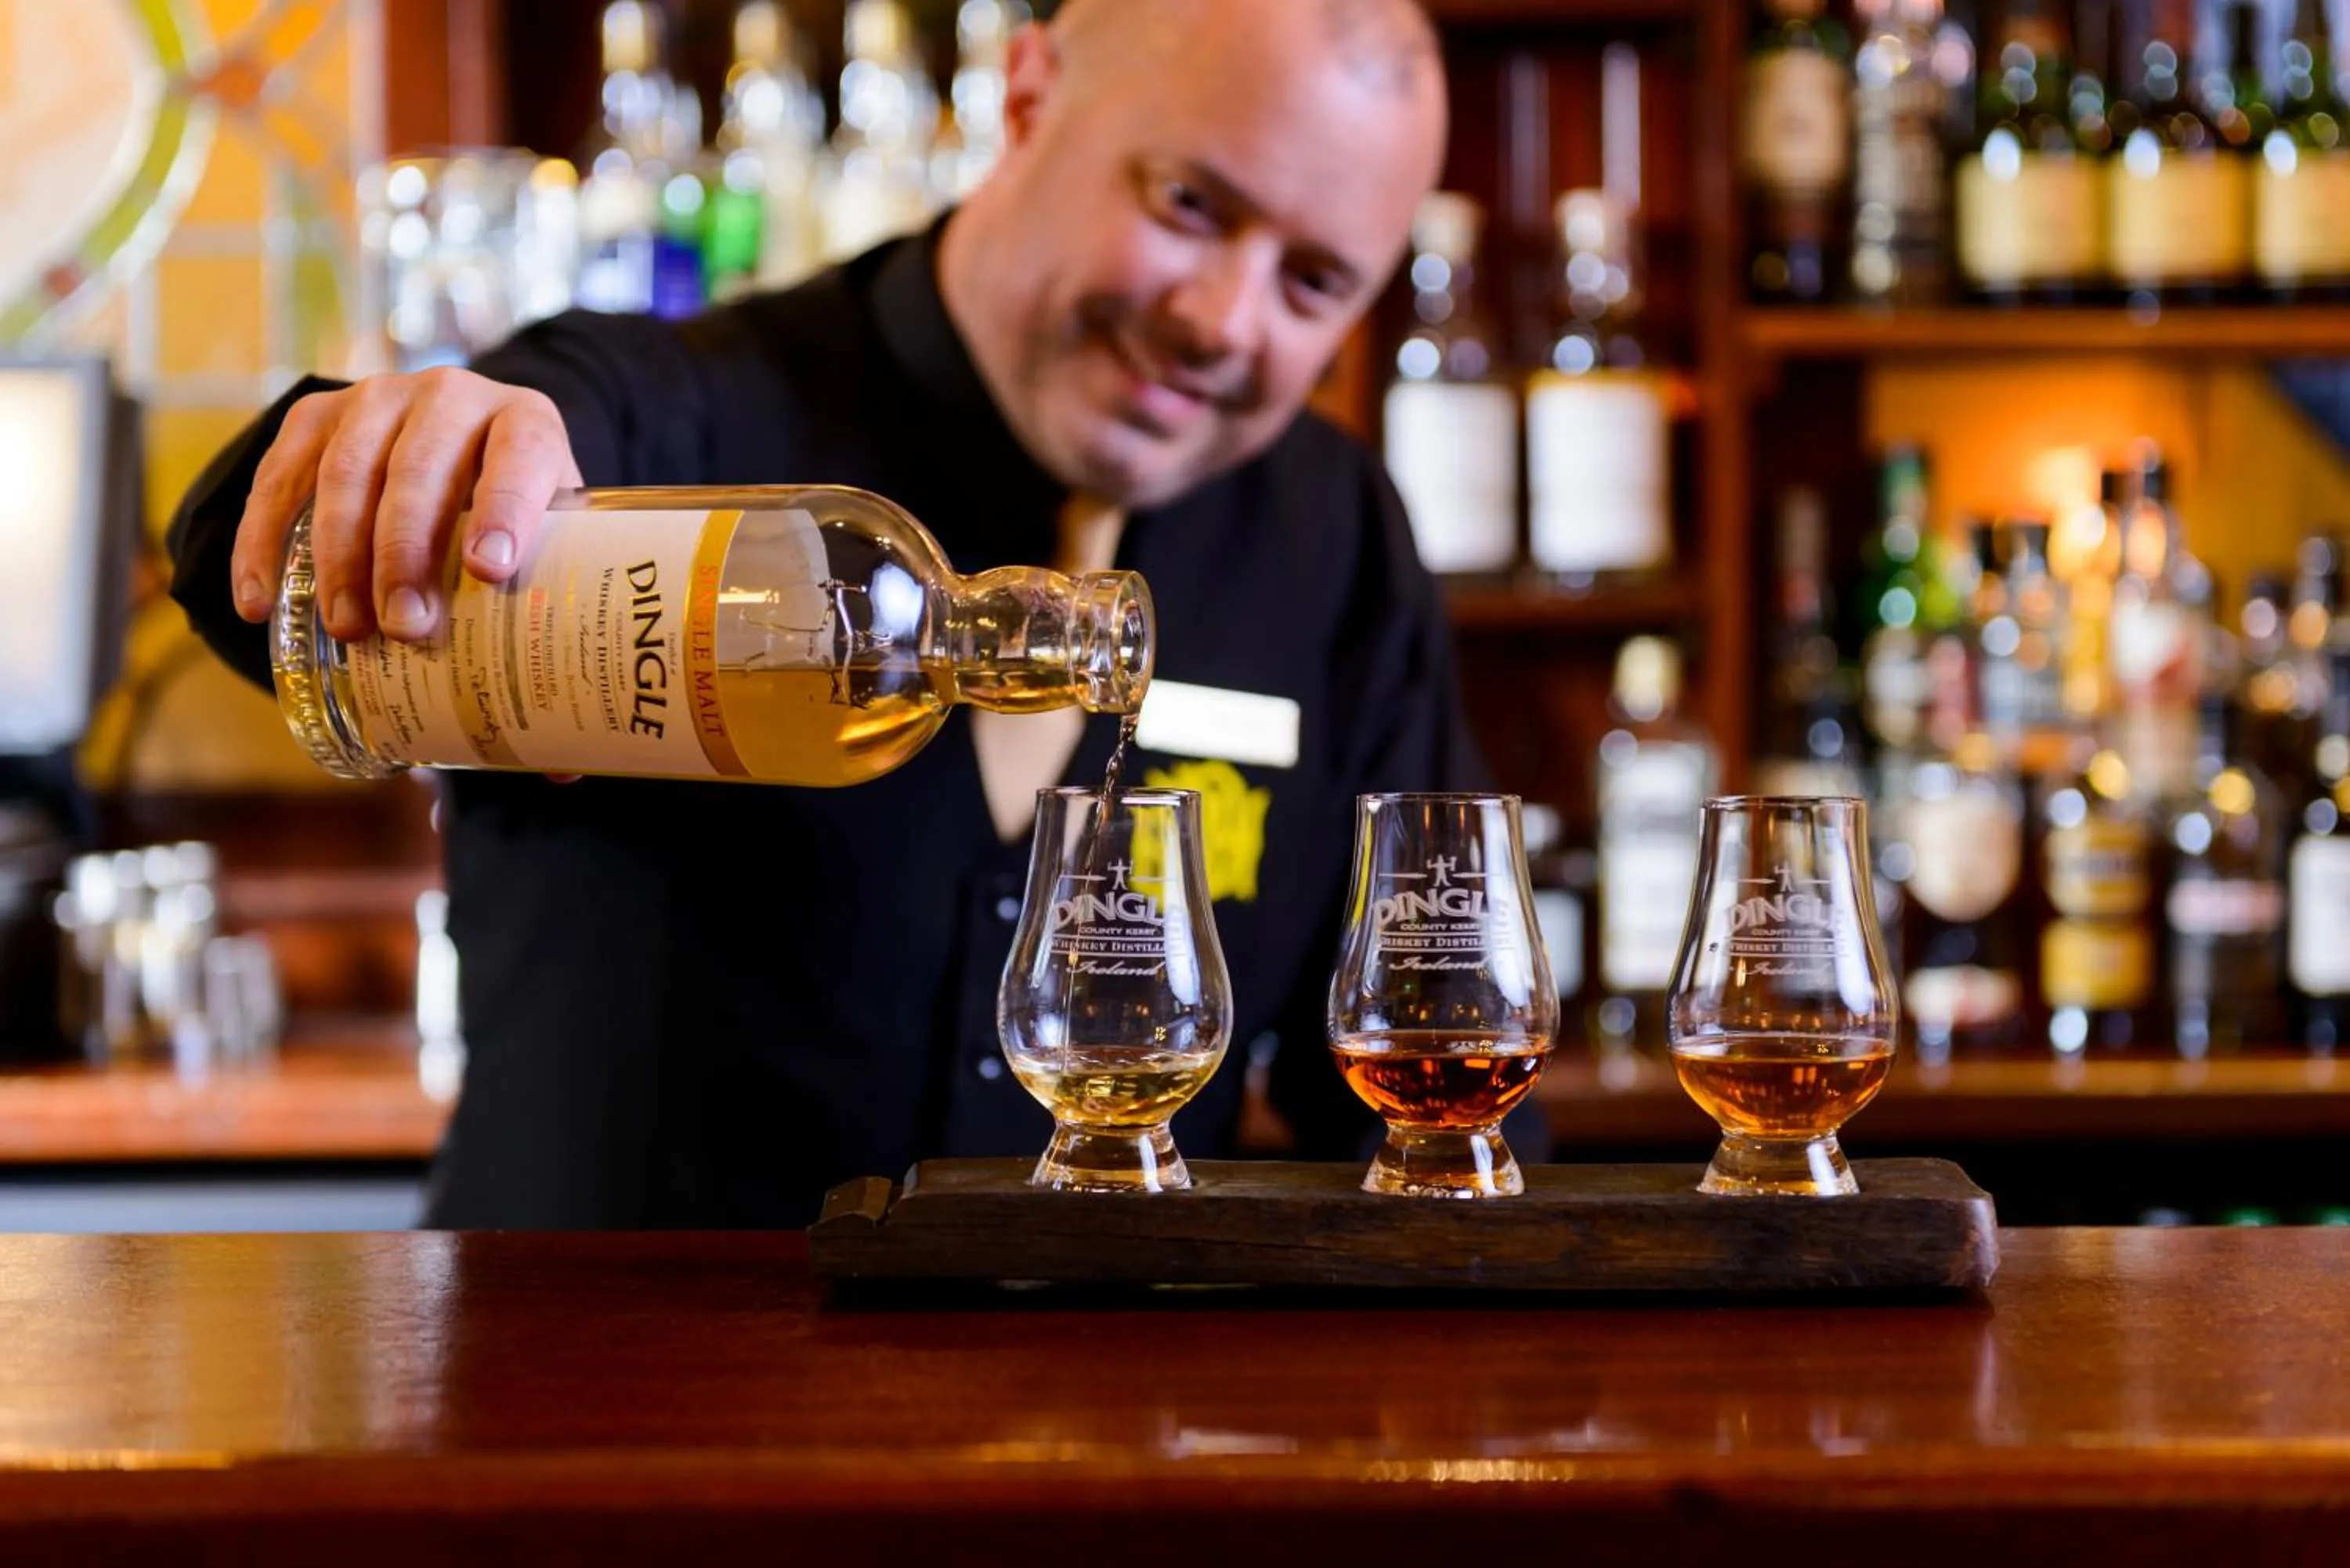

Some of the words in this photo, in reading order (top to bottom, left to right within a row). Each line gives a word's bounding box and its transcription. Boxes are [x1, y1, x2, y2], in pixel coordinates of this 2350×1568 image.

[597, 567, 614, 640] WHISKEY
[692, 564, 717, 661] SINGLE
[530, 638, 548, 711] WHISKEY
[627, 560, 667, 740] DINGLE
[597, 646, 621, 732] DISTILLERY
[693, 670, 724, 737] MALT
[1052, 891, 1181, 932] DINGL
[1079, 927, 1123, 935] COUNTY
[1373, 887, 1509, 927] DINGL
[1726, 893, 1841, 932] DINGL
[1112, 941, 1175, 952] DISTILL
[1436, 938, 1500, 948] DISTIL
